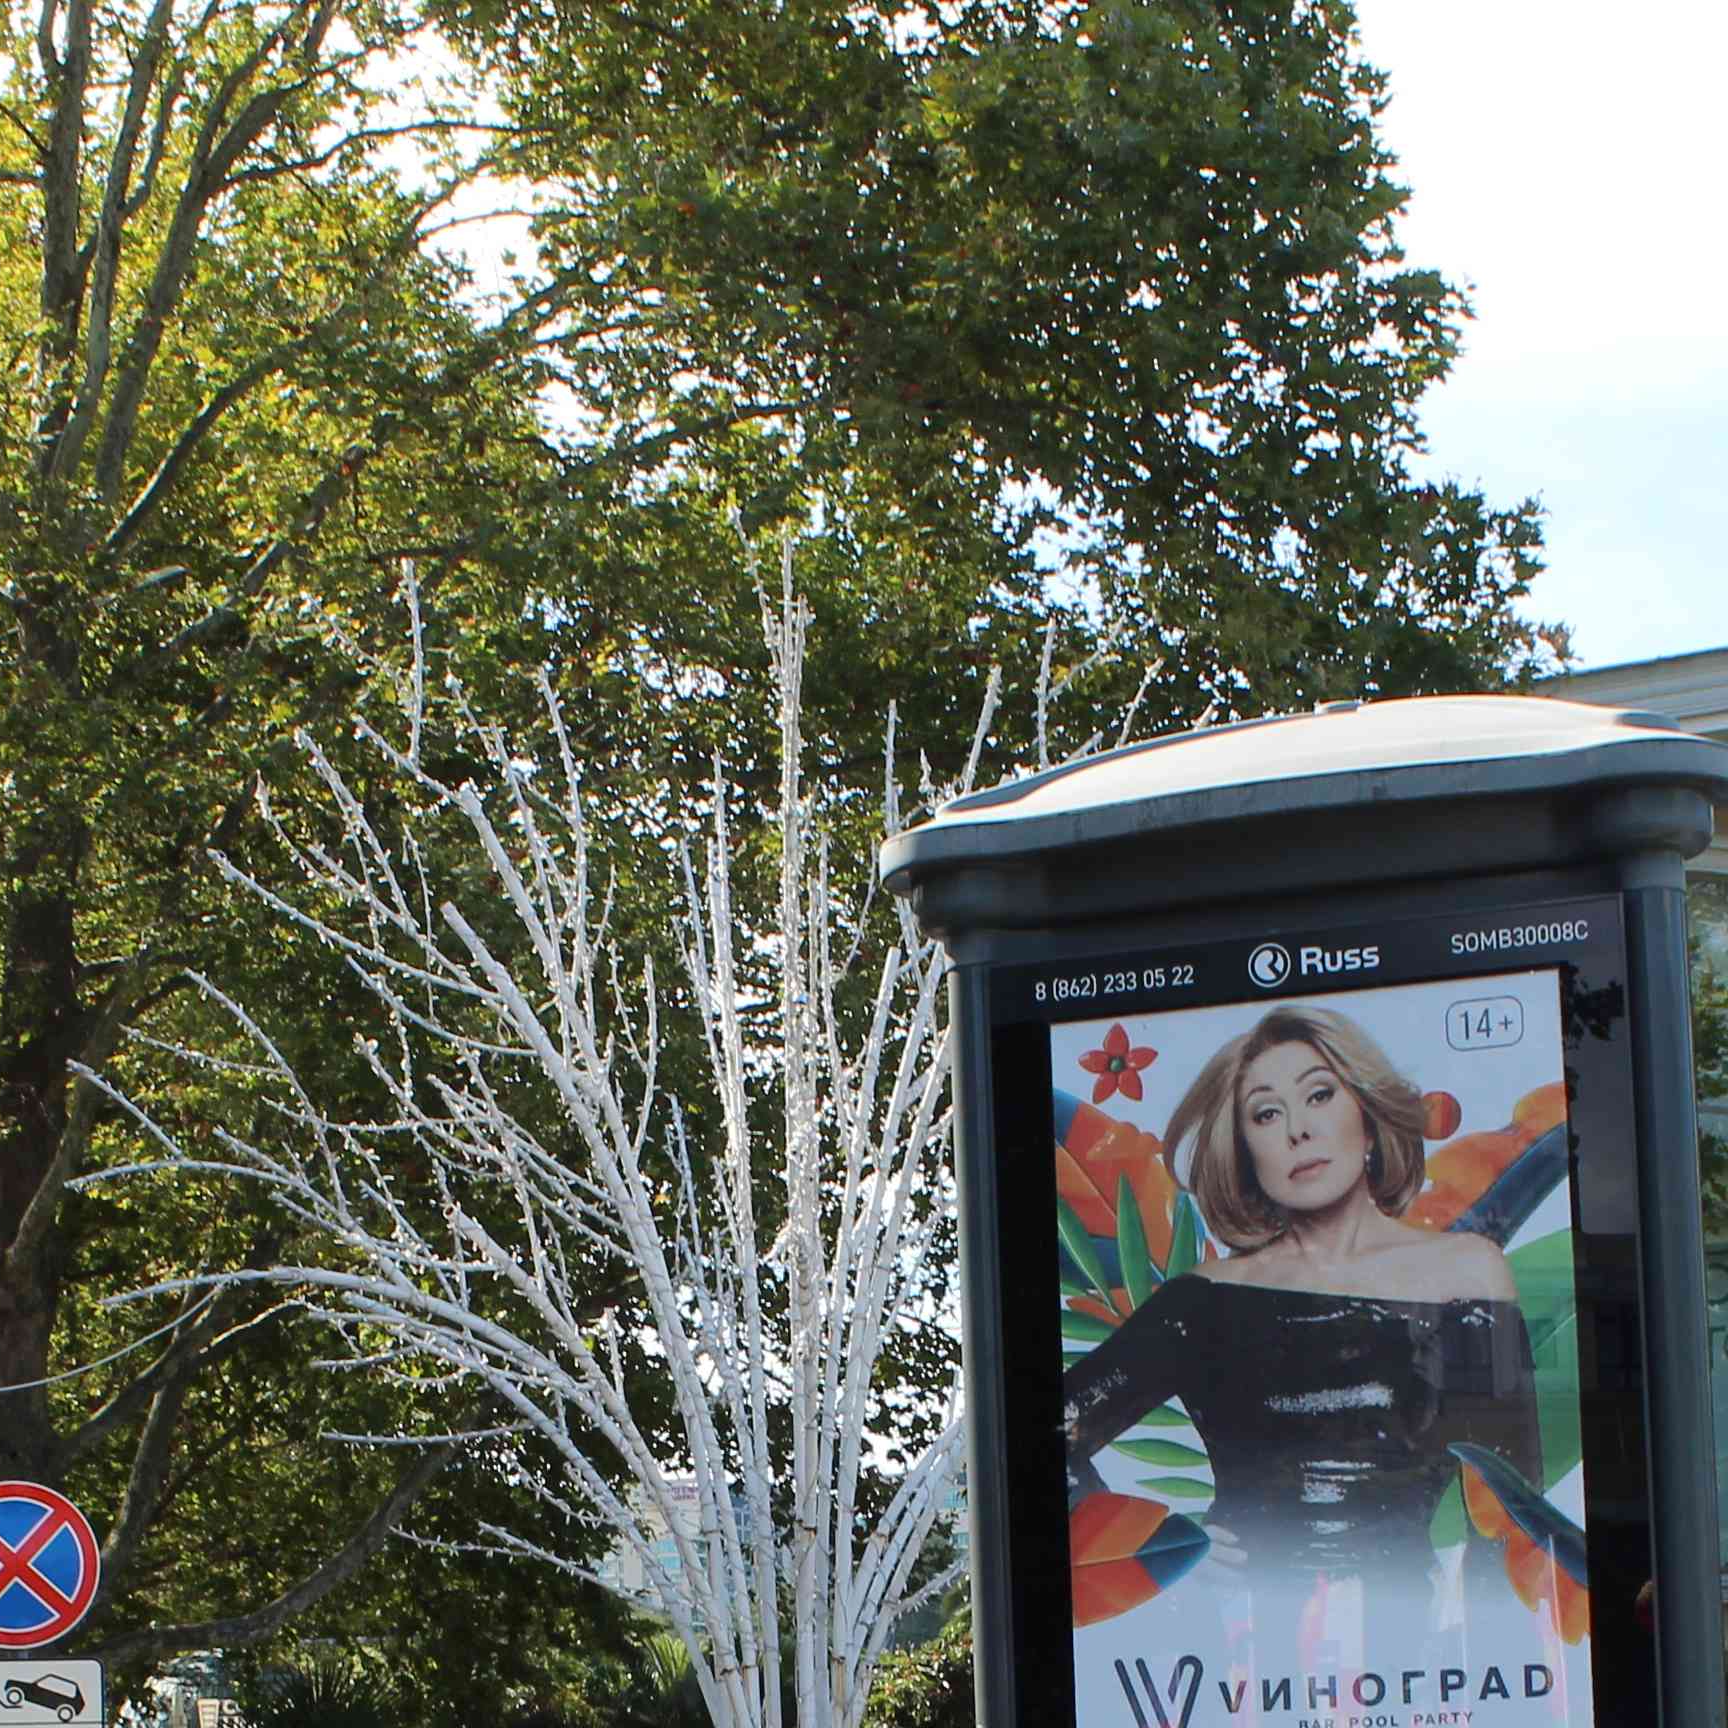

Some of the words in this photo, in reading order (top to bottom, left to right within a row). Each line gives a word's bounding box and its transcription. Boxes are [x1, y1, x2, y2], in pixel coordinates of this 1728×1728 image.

[1450, 919, 1590, 955] SOMB30008C
[1300, 944, 1381, 976] Russ
[1034, 982, 1046, 1001] 8
[1052, 974, 1098, 1000] (862)
[1104, 972, 1137, 994] 233
[1143, 968, 1167, 990] 05
[1171, 965, 1195, 986] 22
[1458, 1007, 1515, 1042] 14+
[1412, 1711, 1474, 1727] PARTY
